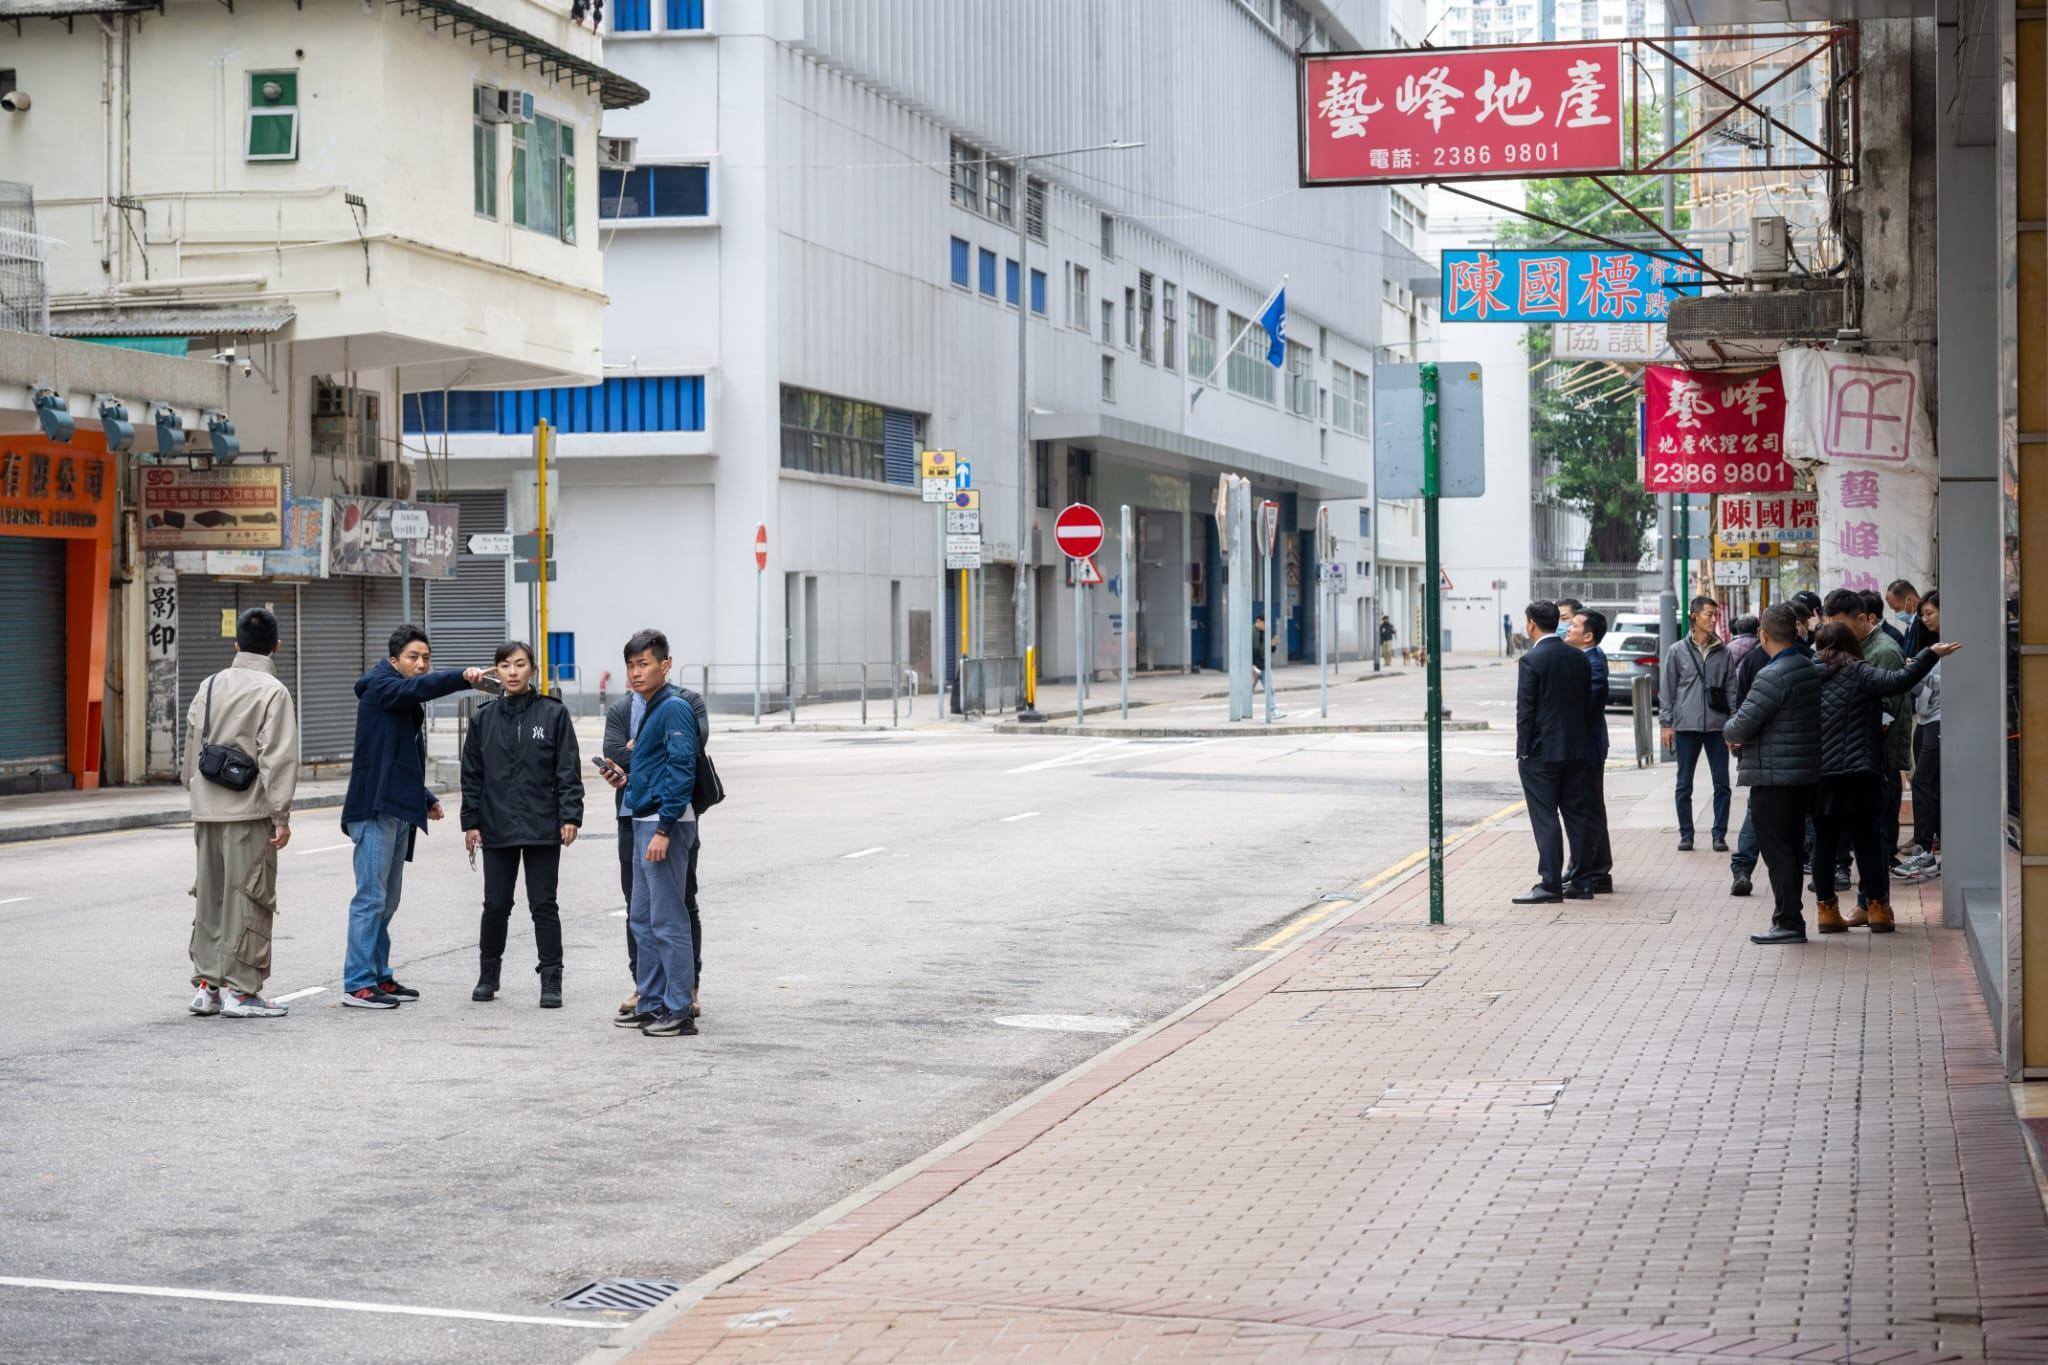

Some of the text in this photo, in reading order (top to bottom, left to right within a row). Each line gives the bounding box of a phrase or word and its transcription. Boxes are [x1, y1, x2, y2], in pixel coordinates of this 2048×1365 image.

[1318, 59, 1612, 139] 藝峰地產
[1433, 145, 1491, 166] 2386
[1504, 142, 1558, 163] 9801
[1448, 252, 1642, 319] 陳國標
[1664, 378, 1775, 428] 藝峰
[1658, 432, 1779, 454] 地產代理公司
[1653, 461, 1785, 484] 2386 9801
[1722, 498, 1819, 530] 陳國標
[1737, 575, 1748, 584] 12
[150, 587, 176, 655] 影印
